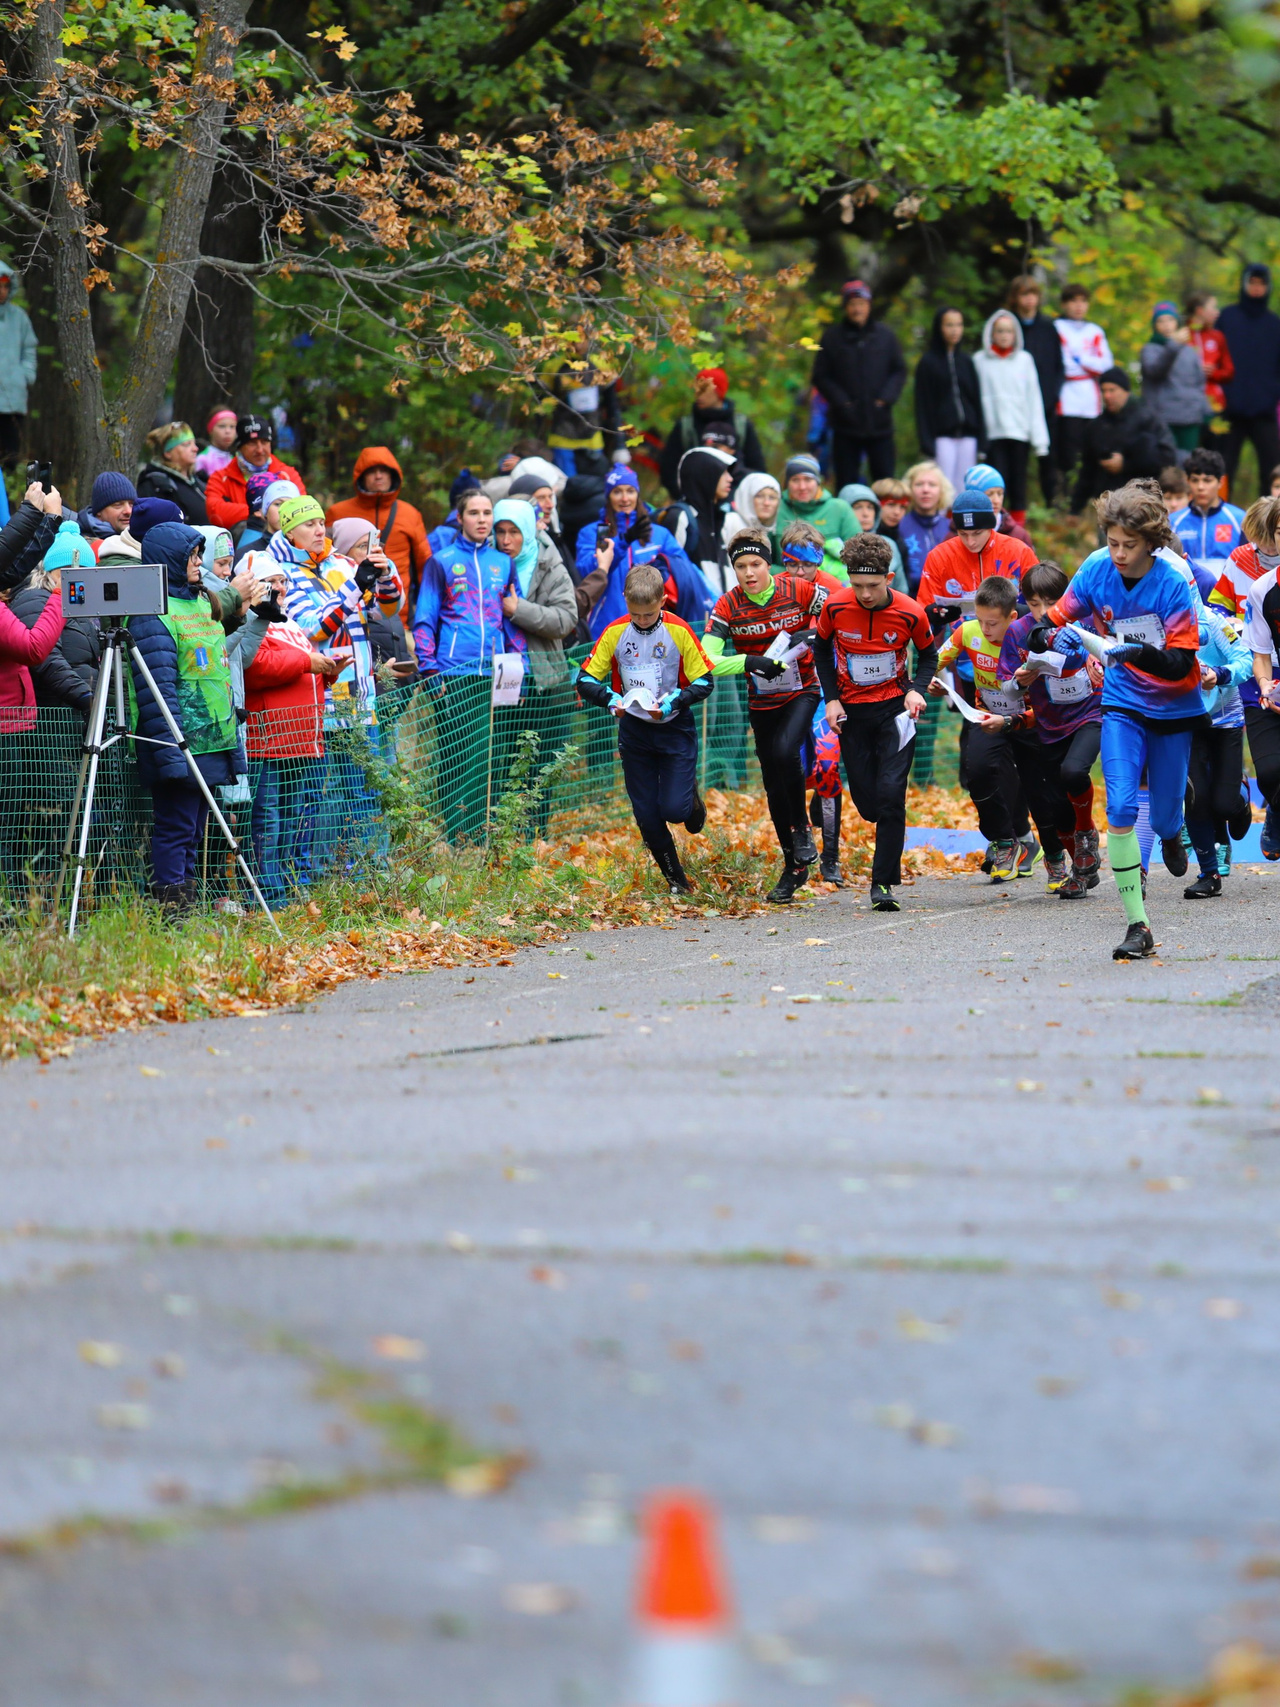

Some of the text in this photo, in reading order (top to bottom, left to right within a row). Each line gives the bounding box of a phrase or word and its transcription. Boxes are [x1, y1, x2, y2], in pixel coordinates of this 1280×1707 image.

[730, 623, 767, 636] NORD
[769, 612, 806, 632] WEST
[863, 666, 881, 675] 284
[629, 679, 645, 688] 296
[1060, 687, 1077, 695] 283
[992, 701, 1008, 709] 294
